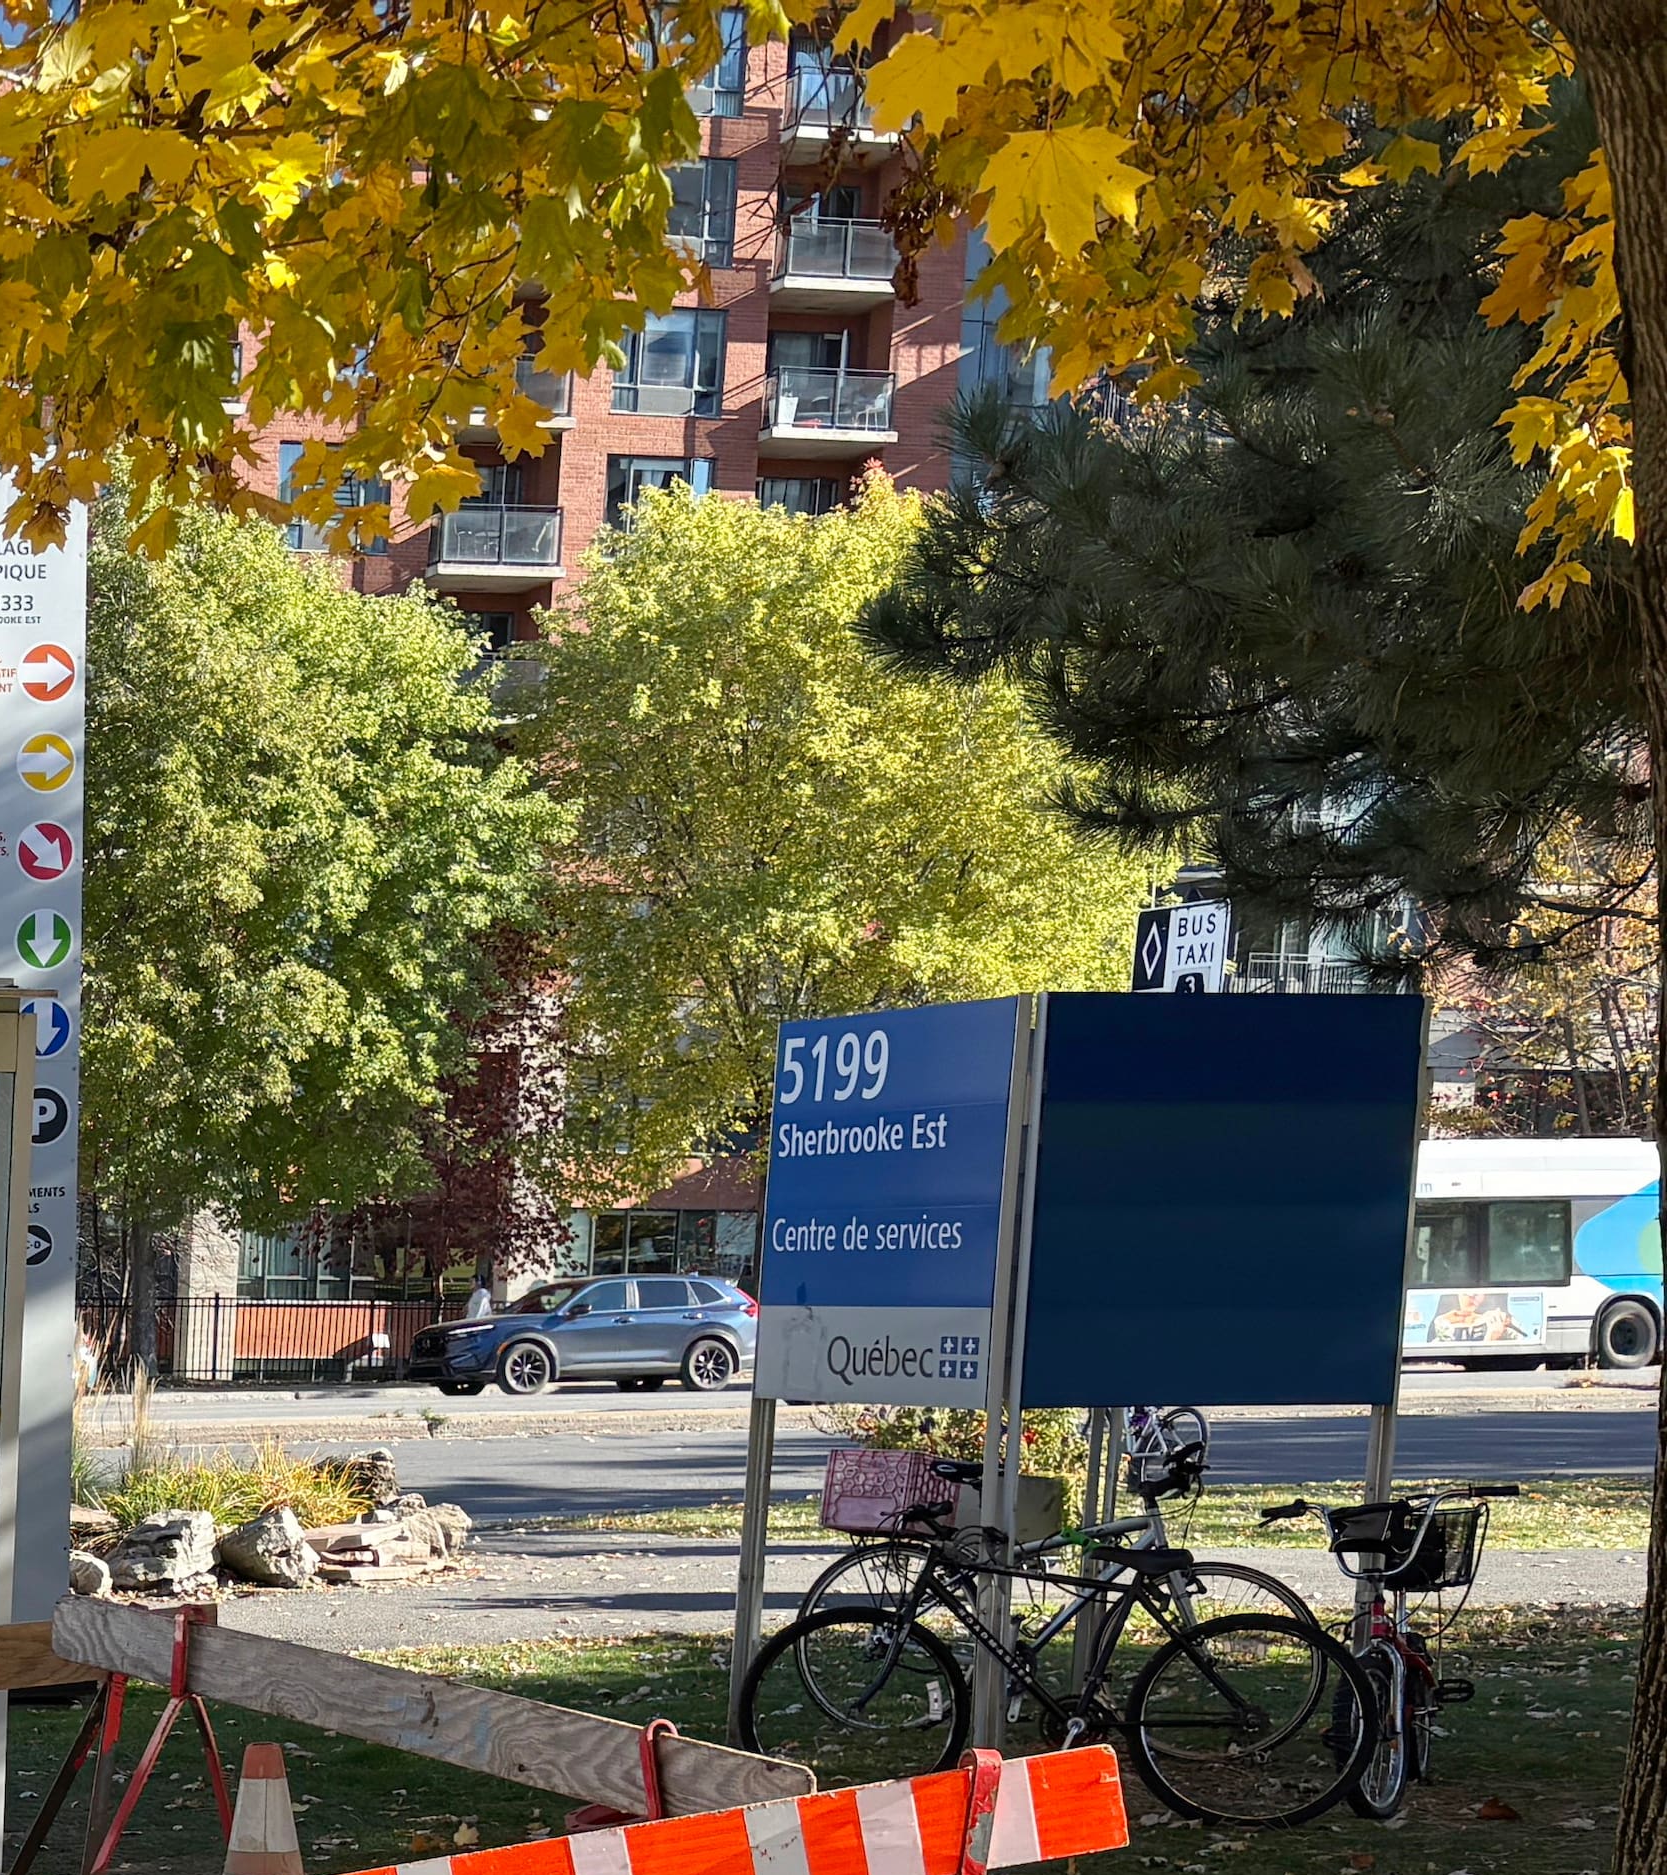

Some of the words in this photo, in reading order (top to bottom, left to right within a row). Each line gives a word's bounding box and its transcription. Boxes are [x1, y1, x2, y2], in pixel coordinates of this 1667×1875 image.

[25, 616, 41, 625] EST
[1177, 912, 1217, 937] BUS
[1176, 941, 1215, 966] TAXI
[779, 1030, 890, 1105] 5199
[778, 1116, 904, 1158] Sherbrooke
[912, 1113, 948, 1149] Est
[772, 1217, 836, 1251] Centre
[843, 1216, 869, 1250] de
[874, 1214, 962, 1250] services
[827, 1335, 934, 1386] Québec
